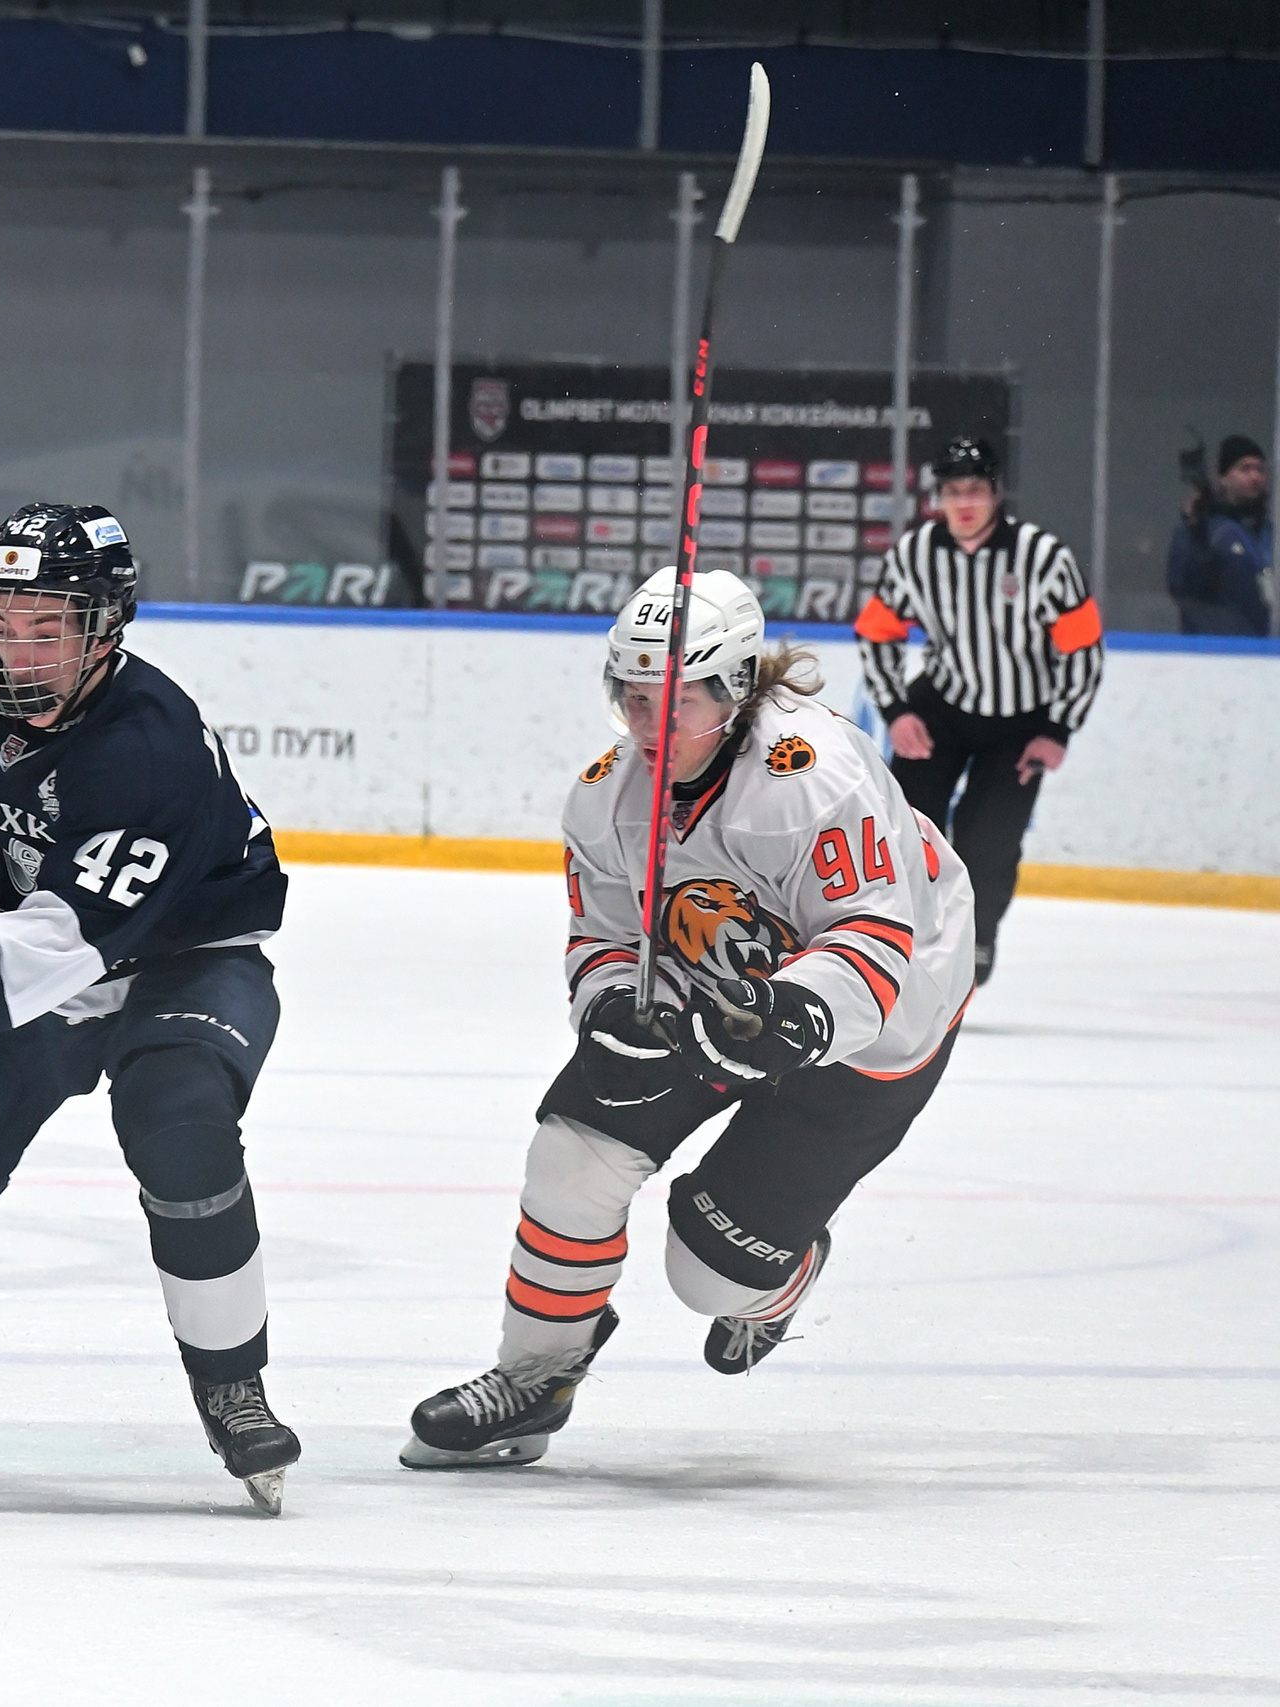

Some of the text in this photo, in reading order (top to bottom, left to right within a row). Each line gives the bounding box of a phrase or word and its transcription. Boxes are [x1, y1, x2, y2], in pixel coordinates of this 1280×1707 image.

[879, 405, 931, 429] ЛГА
[634, 603, 671, 626] 94
[217, 724, 357, 759] ГО ПУТИ
[73, 828, 170, 909] 42
[811, 816, 896, 901] 94
